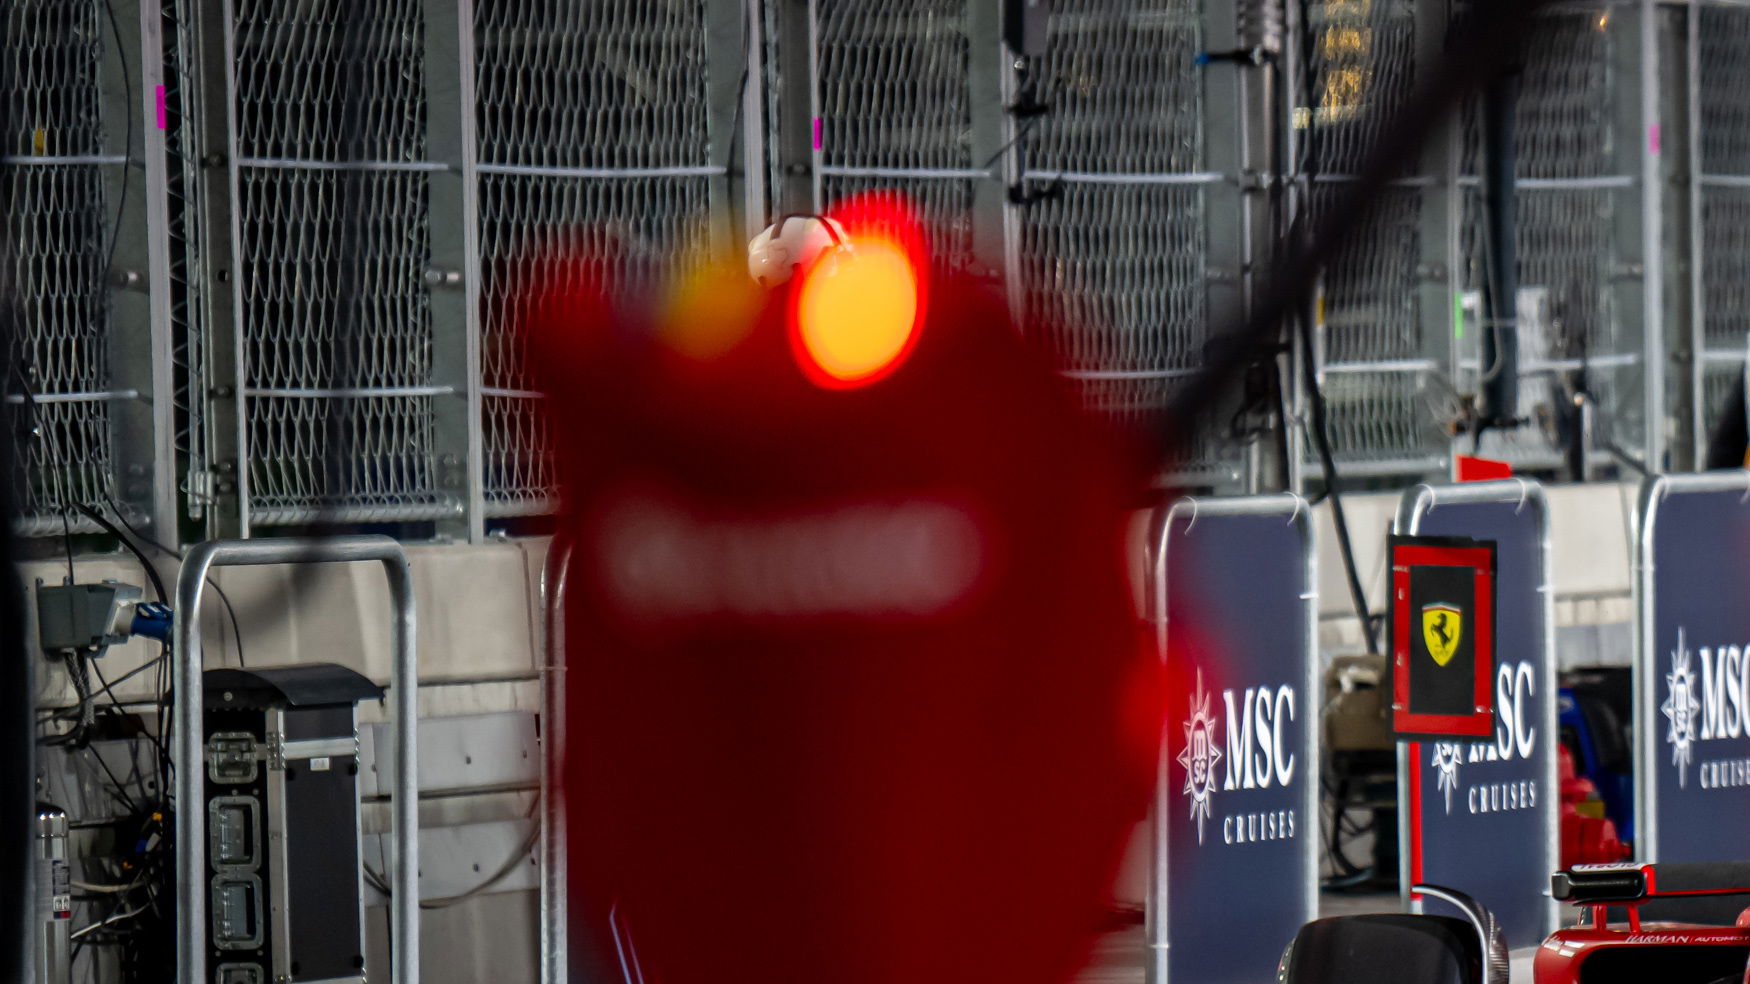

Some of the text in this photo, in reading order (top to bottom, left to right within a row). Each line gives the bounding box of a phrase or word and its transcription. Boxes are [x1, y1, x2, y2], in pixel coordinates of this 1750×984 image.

[1468, 662, 1535, 764] SC
[1222, 684, 1295, 791] MSC
[1468, 781, 1535, 815] CRUISES
[1223, 811, 1295, 845] CRUISES
[1624, 935, 1690, 945] HARMAN
